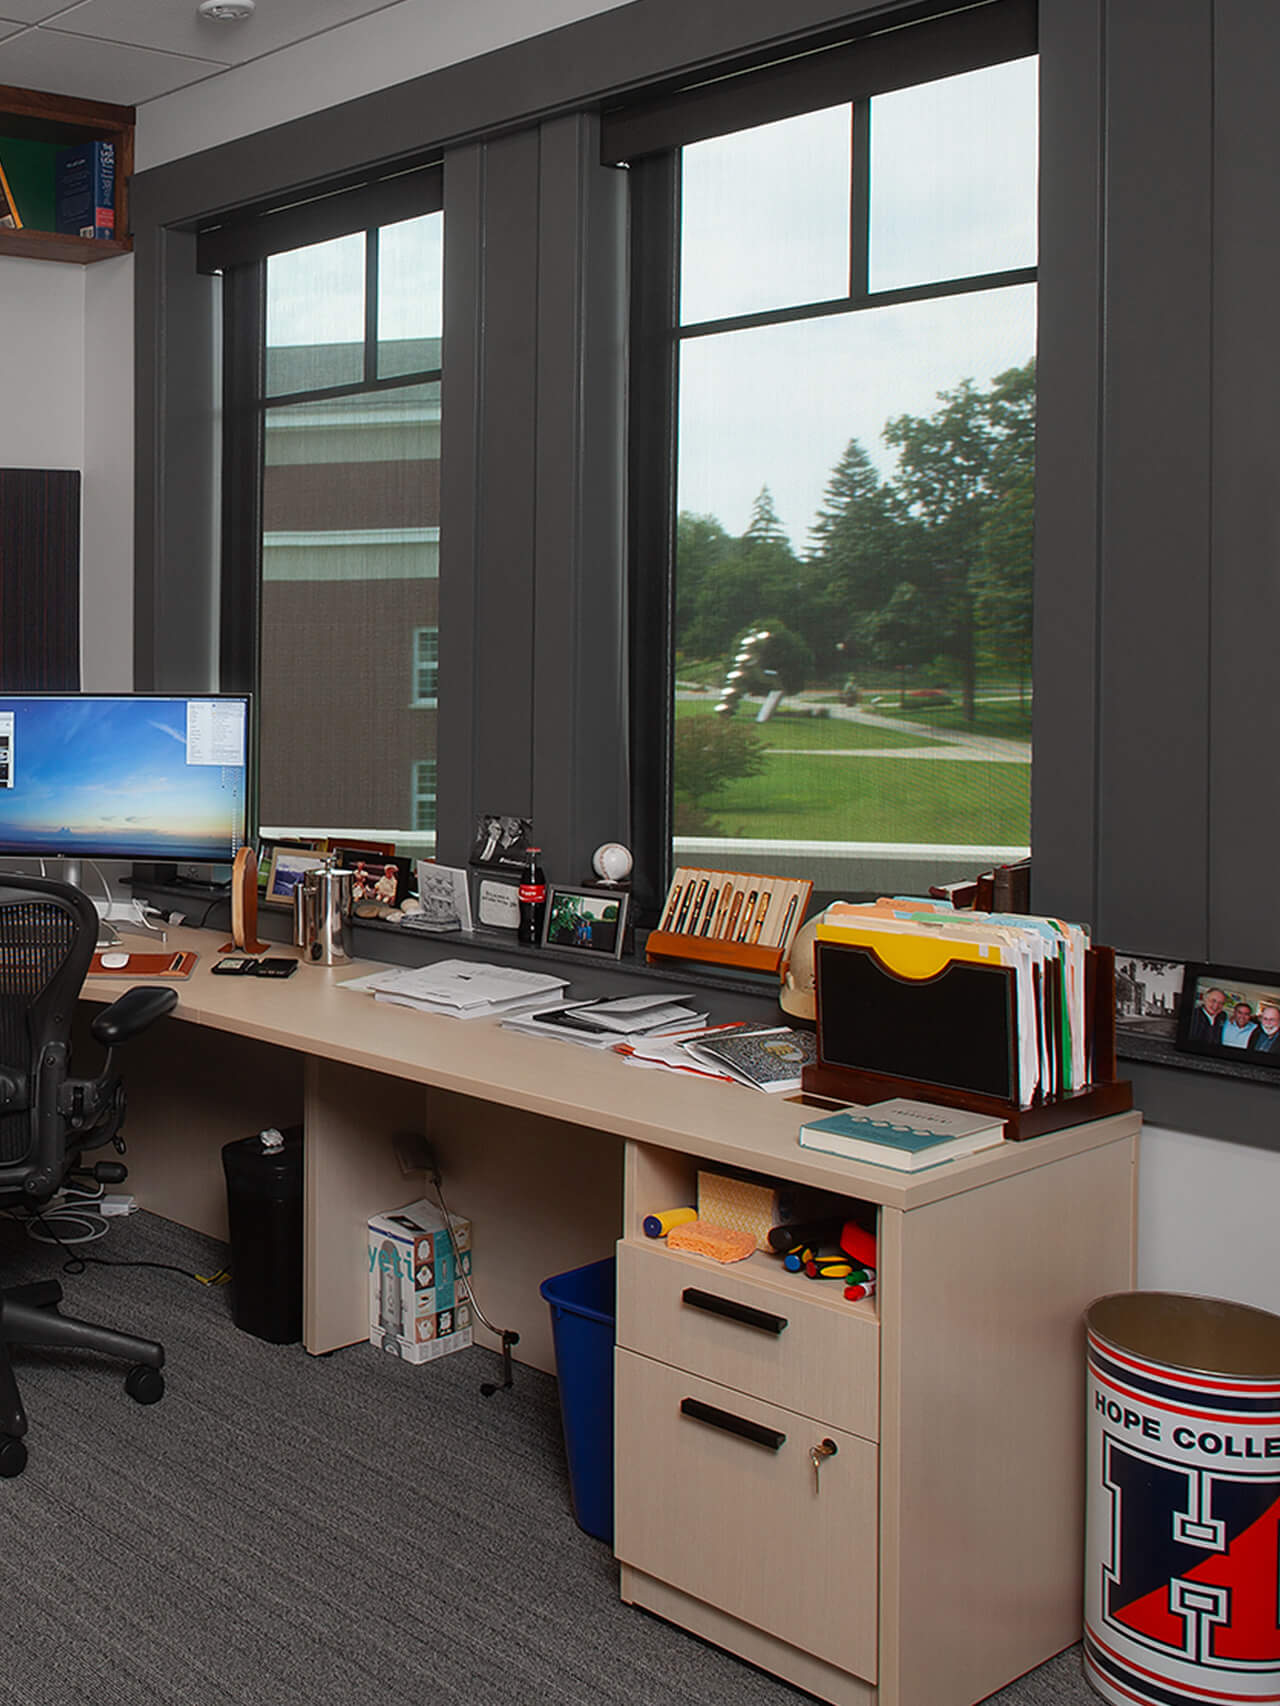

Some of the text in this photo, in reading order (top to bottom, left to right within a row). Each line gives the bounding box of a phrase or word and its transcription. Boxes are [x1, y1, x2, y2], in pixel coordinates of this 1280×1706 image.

[368, 1244, 416, 1283] yeti
[1094, 1390, 1280, 1459] HOPE COLLE
